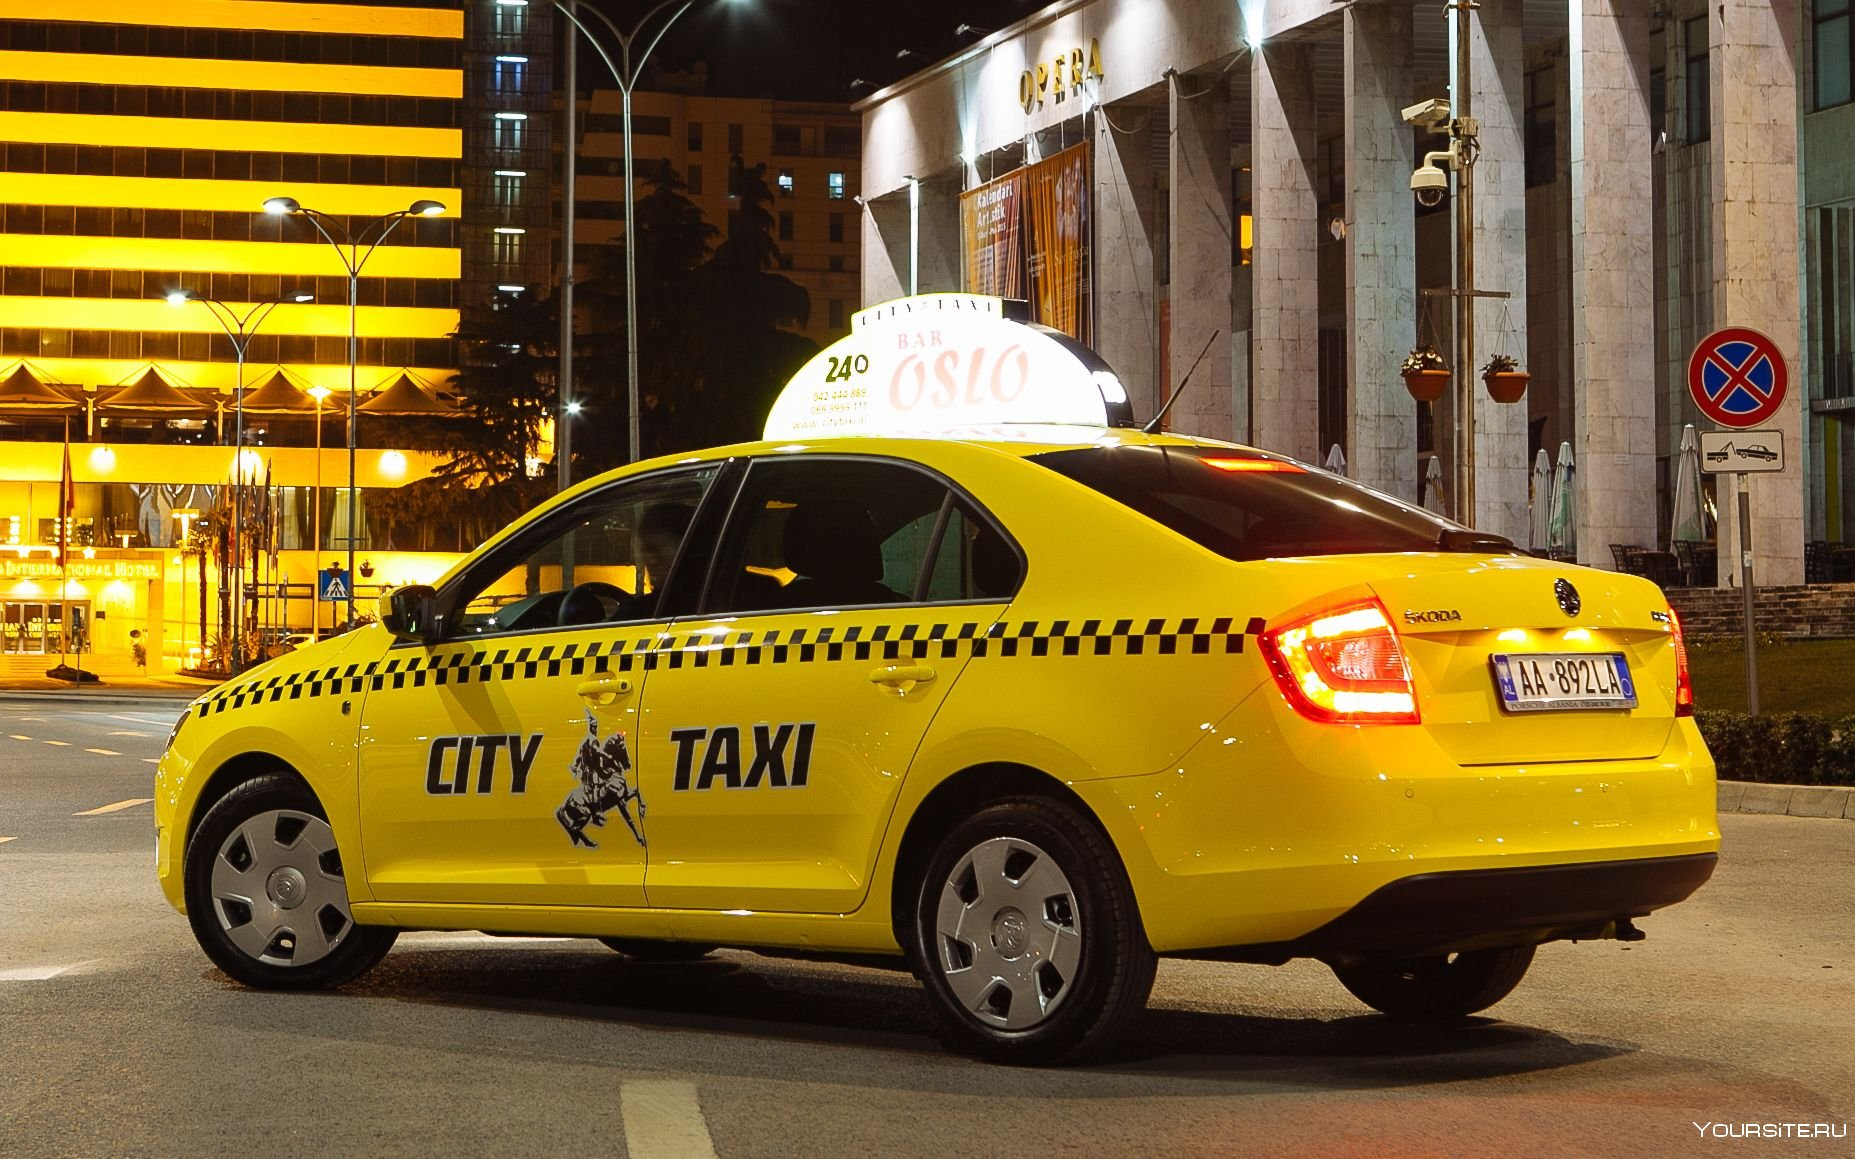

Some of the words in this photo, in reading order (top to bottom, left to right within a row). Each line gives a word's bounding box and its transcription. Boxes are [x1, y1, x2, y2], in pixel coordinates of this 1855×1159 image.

[1019, 37, 1104, 115] OPERA
[978, 180, 1013, 209] Kalendari
[977, 201, 1006, 228] Artstik
[897, 330, 943, 350] BAR
[888, 343, 1029, 412] OSLO
[115, 562, 160, 577] HOTEL
[426, 734, 544, 795] CITY
[670, 723, 816, 791] TAXI
